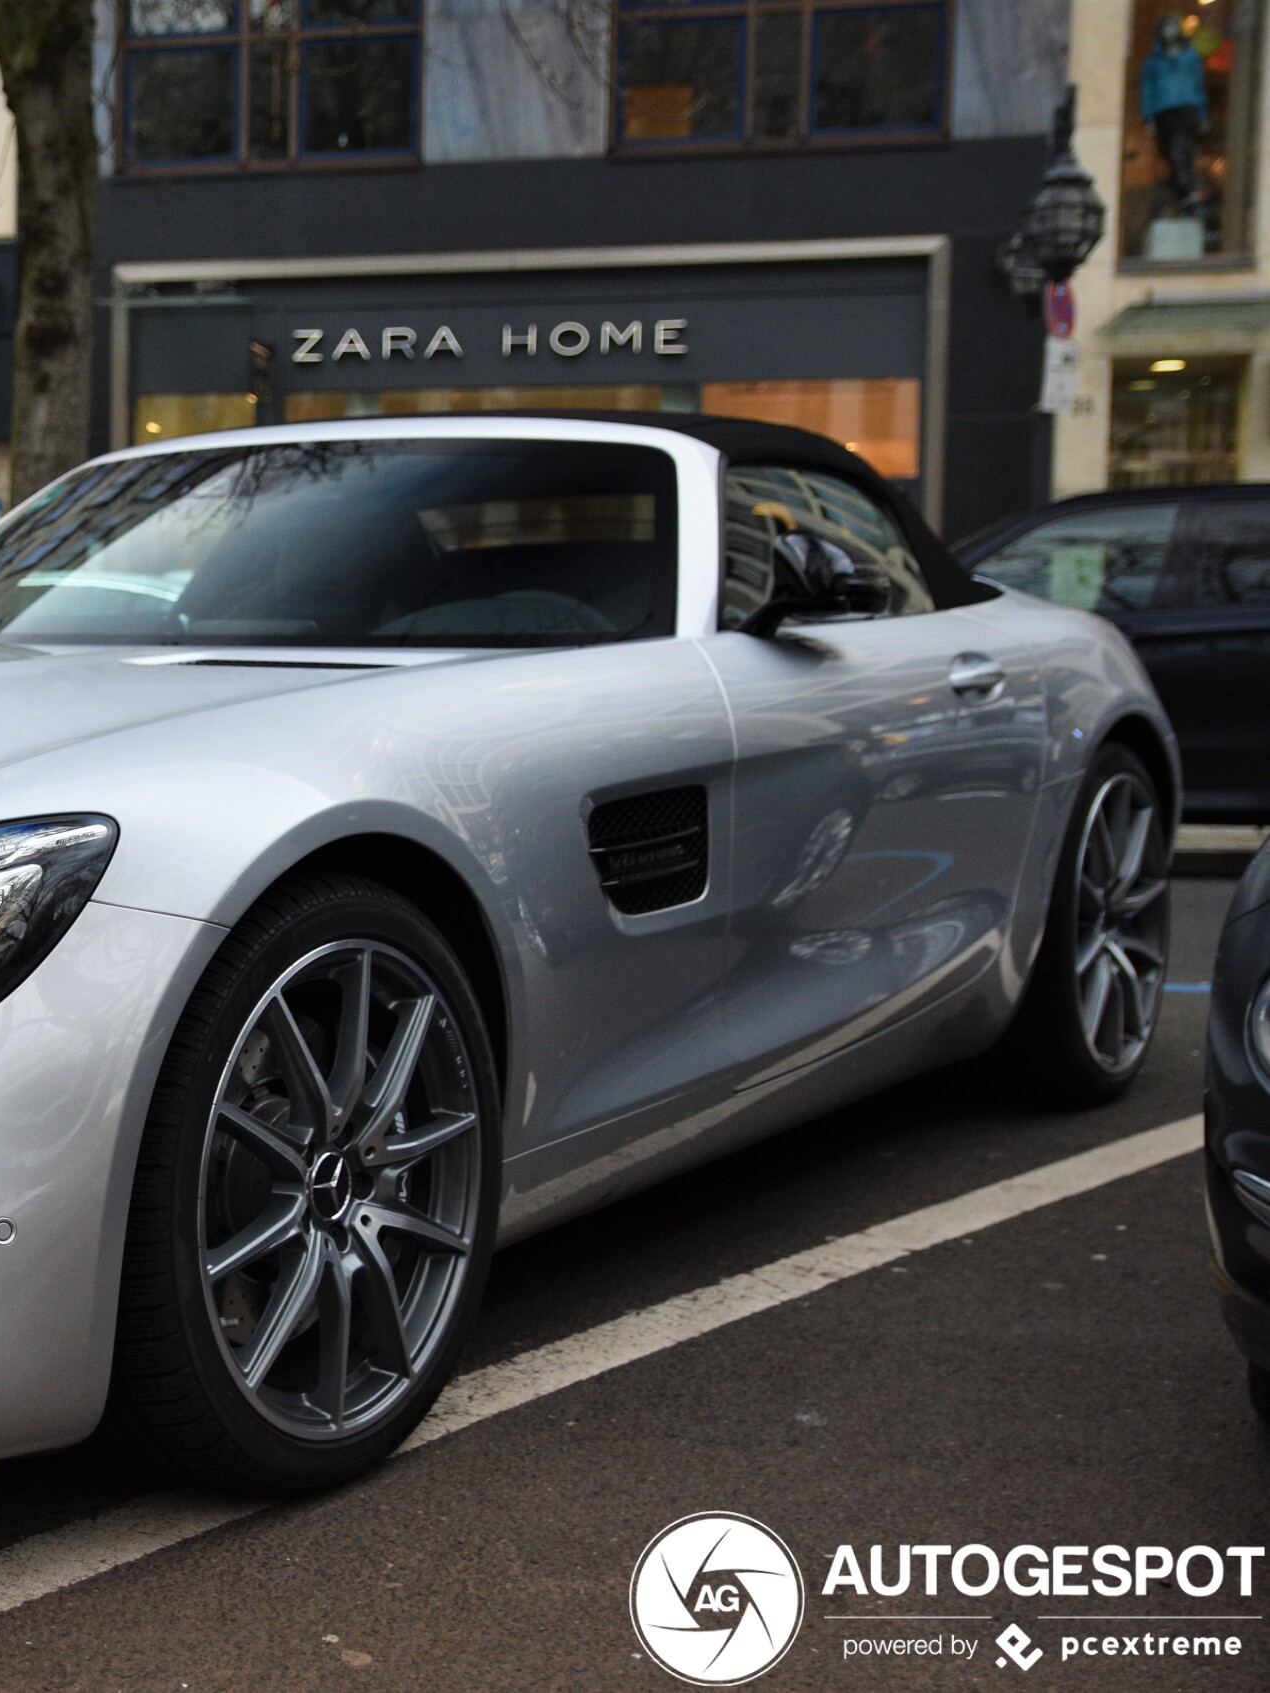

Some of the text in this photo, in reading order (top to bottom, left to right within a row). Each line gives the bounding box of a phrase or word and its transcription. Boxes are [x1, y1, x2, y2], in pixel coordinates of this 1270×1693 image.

[292, 318, 690, 364] ZARA HOME
[68, 831, 96, 841] AMG
